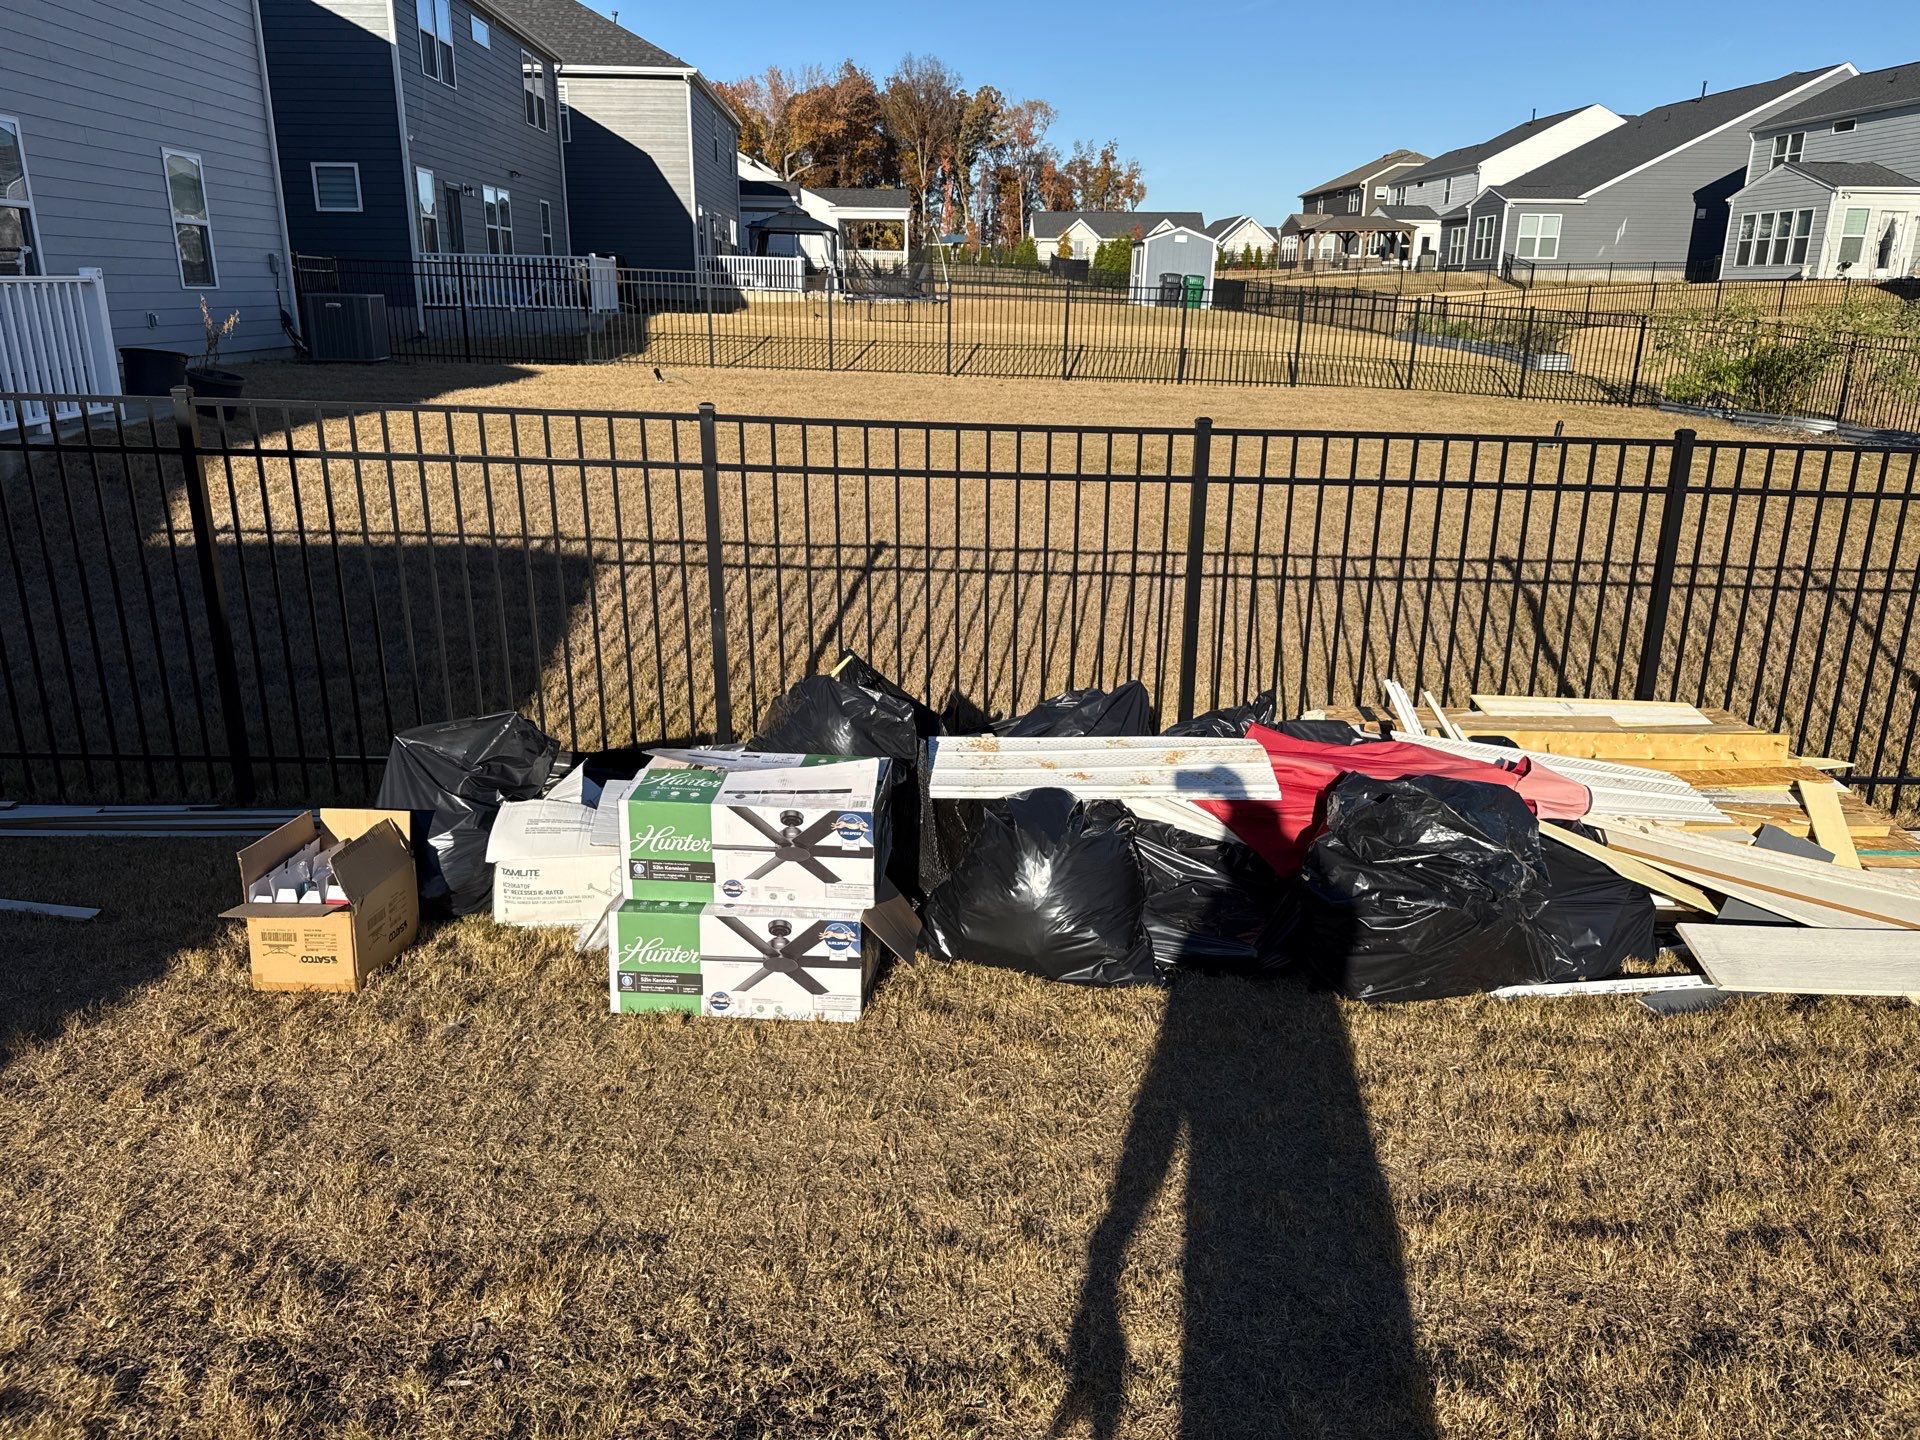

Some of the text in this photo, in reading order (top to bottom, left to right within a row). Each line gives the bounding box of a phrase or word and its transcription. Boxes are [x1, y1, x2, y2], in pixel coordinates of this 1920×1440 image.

[639, 772, 722, 788] Hunter
[630, 824, 712, 853] Hunter
[501, 868, 540, 877] TAMLITE
[618, 936, 700, 964] Hunter
[301, 955, 331, 964] SATCO
